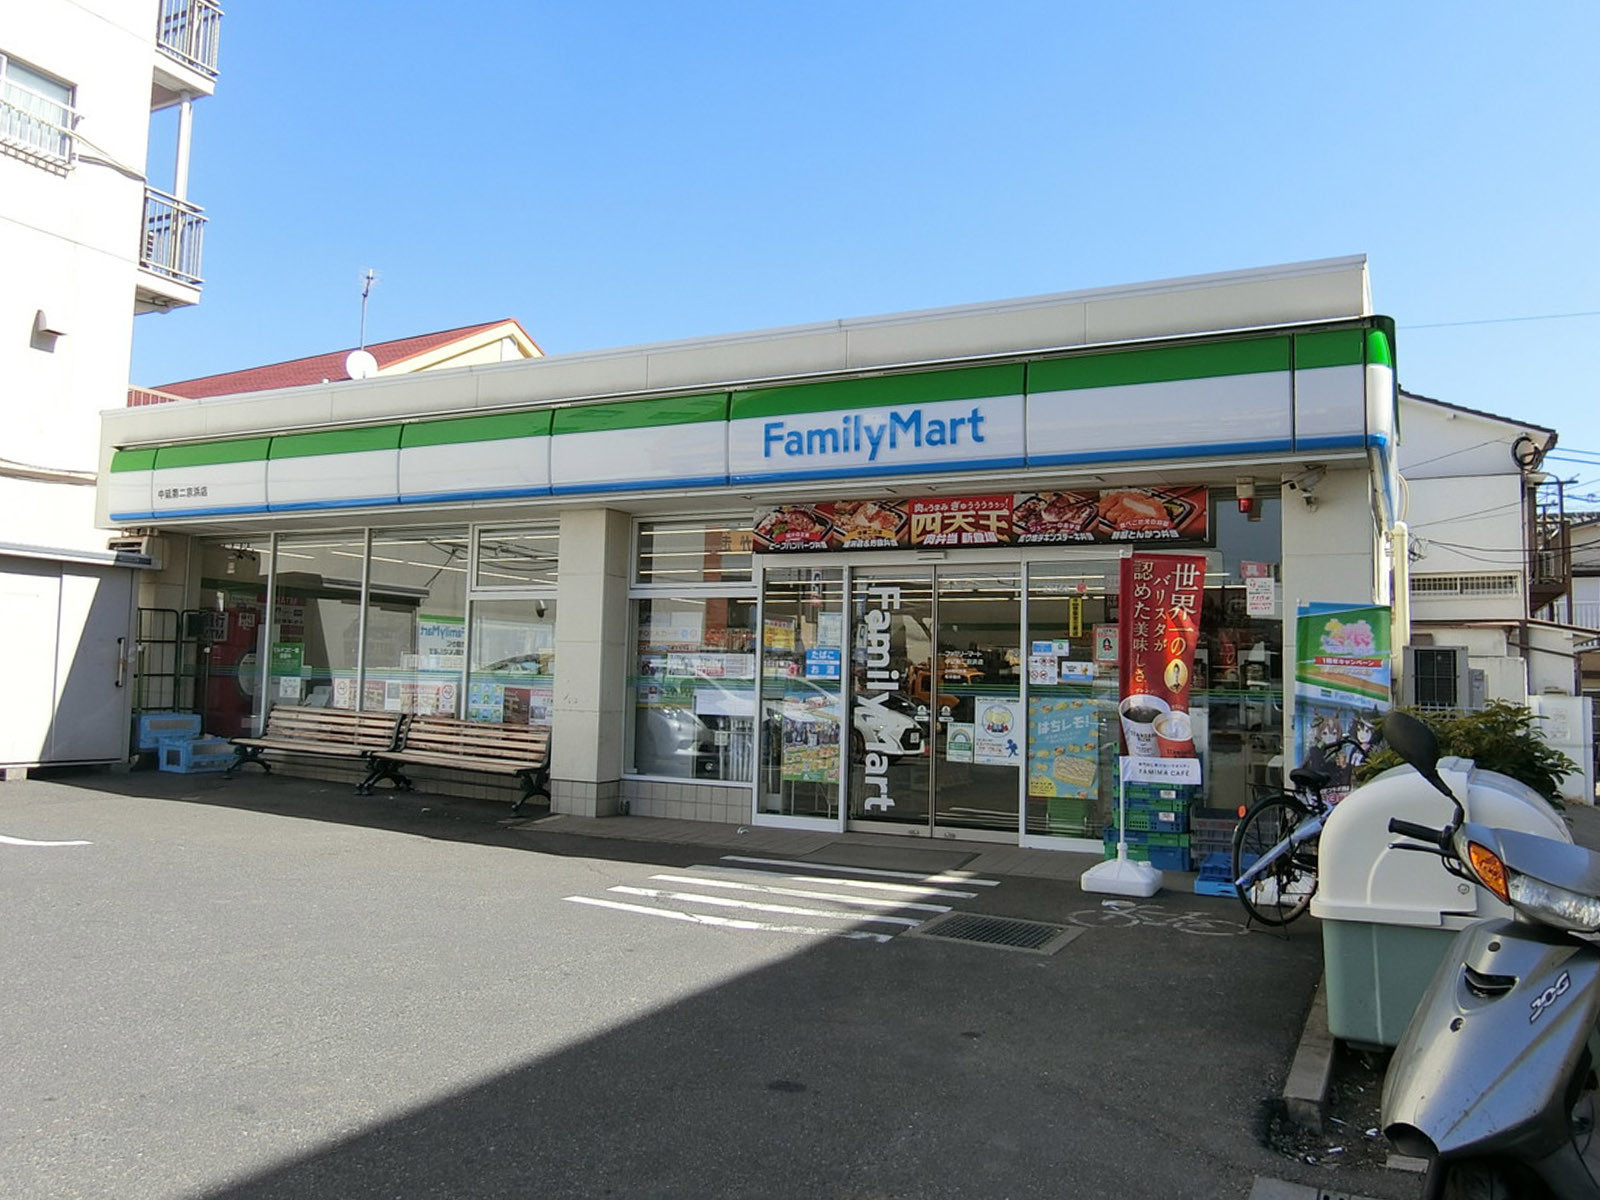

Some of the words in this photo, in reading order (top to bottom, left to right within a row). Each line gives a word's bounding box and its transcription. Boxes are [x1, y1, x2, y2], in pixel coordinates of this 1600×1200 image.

[764, 407, 985, 461] FamilyMart
[911, 509, 1011, 544] 四天王
[1133, 560, 1154, 683] 認めた美味しさ
[1153, 574, 1171, 652] バリスタが
[1168, 563, 1201, 656] 世界一の
[811, 650, 835, 660] たばこ
[857, 586, 901, 812] FamilyMart
[1529, 970, 1571, 1023] JOG
